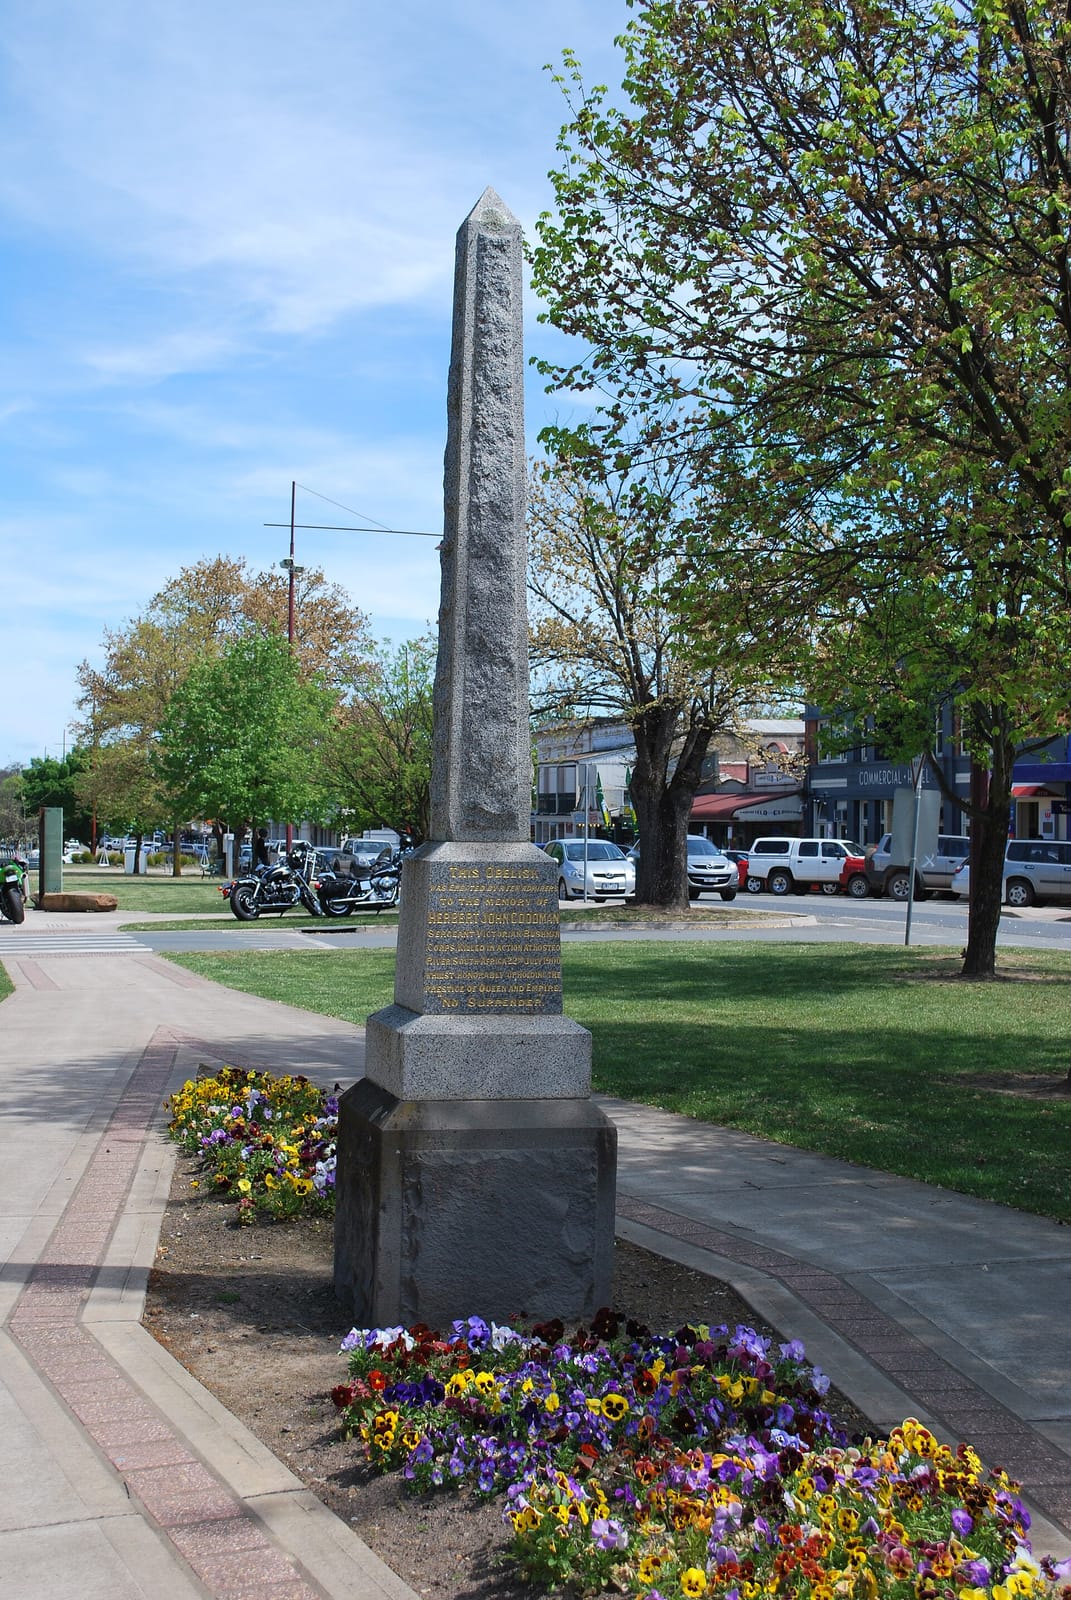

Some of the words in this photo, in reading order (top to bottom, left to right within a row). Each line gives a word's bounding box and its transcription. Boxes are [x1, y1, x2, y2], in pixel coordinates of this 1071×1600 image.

[859, 769, 902, 786] COMMERCIAL
[908, 767, 931, 785] HEL
[449, 867, 480, 879] THIS
[486, 867, 540, 879] OBELISK
[431, 884, 446, 892] WAS
[428, 912, 480, 924] HERBERT
[481, 912, 510, 924] JOHN
[428, 930, 476, 938] SERGEANT
[477, 930, 522, 938] VICTORIAN
[496, 944, 522, 952] ACTION
[426, 958, 451, 966] RIVER
[452, 958, 480, 966] SOUTH
[479, 984, 506, 992] QUEEN
[508, 984, 524, 992] AND
